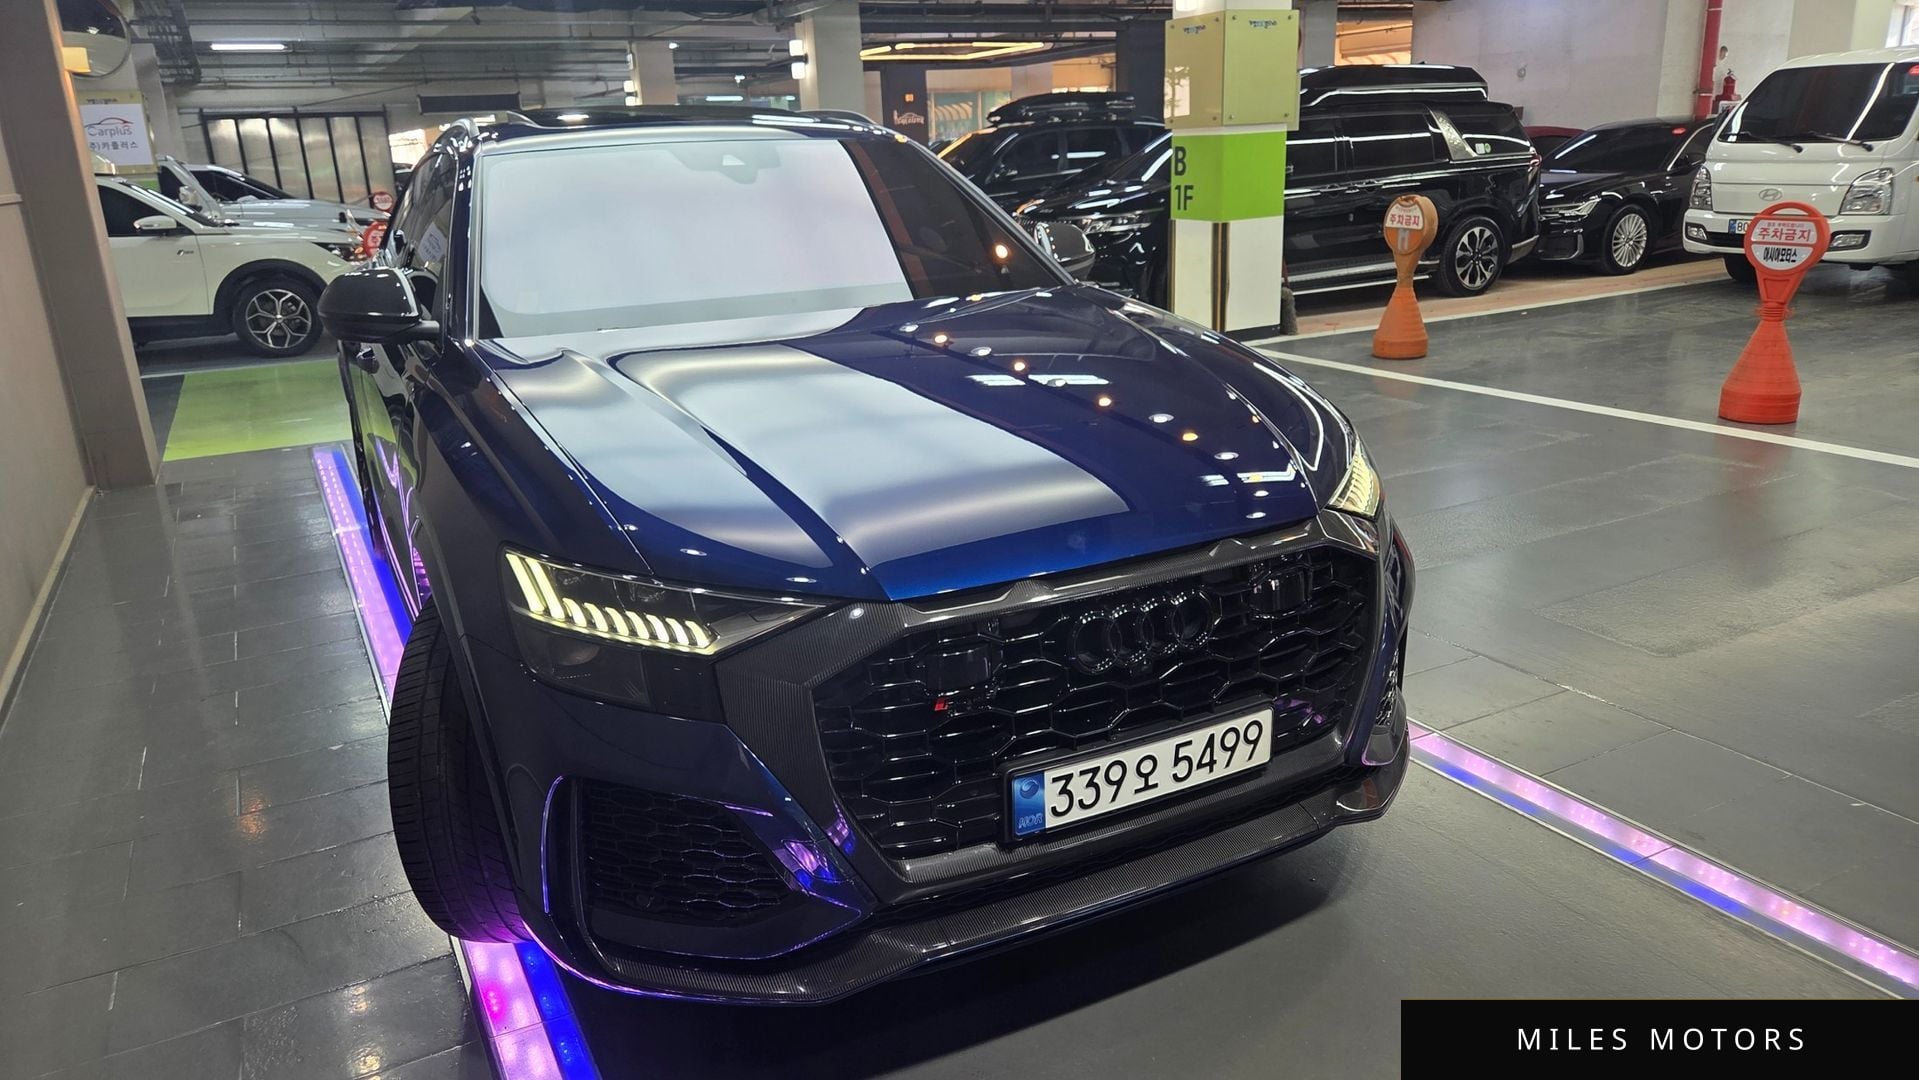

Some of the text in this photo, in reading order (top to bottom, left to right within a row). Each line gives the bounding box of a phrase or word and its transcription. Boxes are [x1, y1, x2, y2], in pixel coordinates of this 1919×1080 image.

[88, 126, 133, 138] Carplus
[1174, 146, 1187, 176] B
[1174, 184, 1194, 211] 1F
[1390, 213, 1420, 227] 주차금지
[1758, 227, 1811, 242] 주차금지
[1050, 719, 1264, 818] 339오 5499
